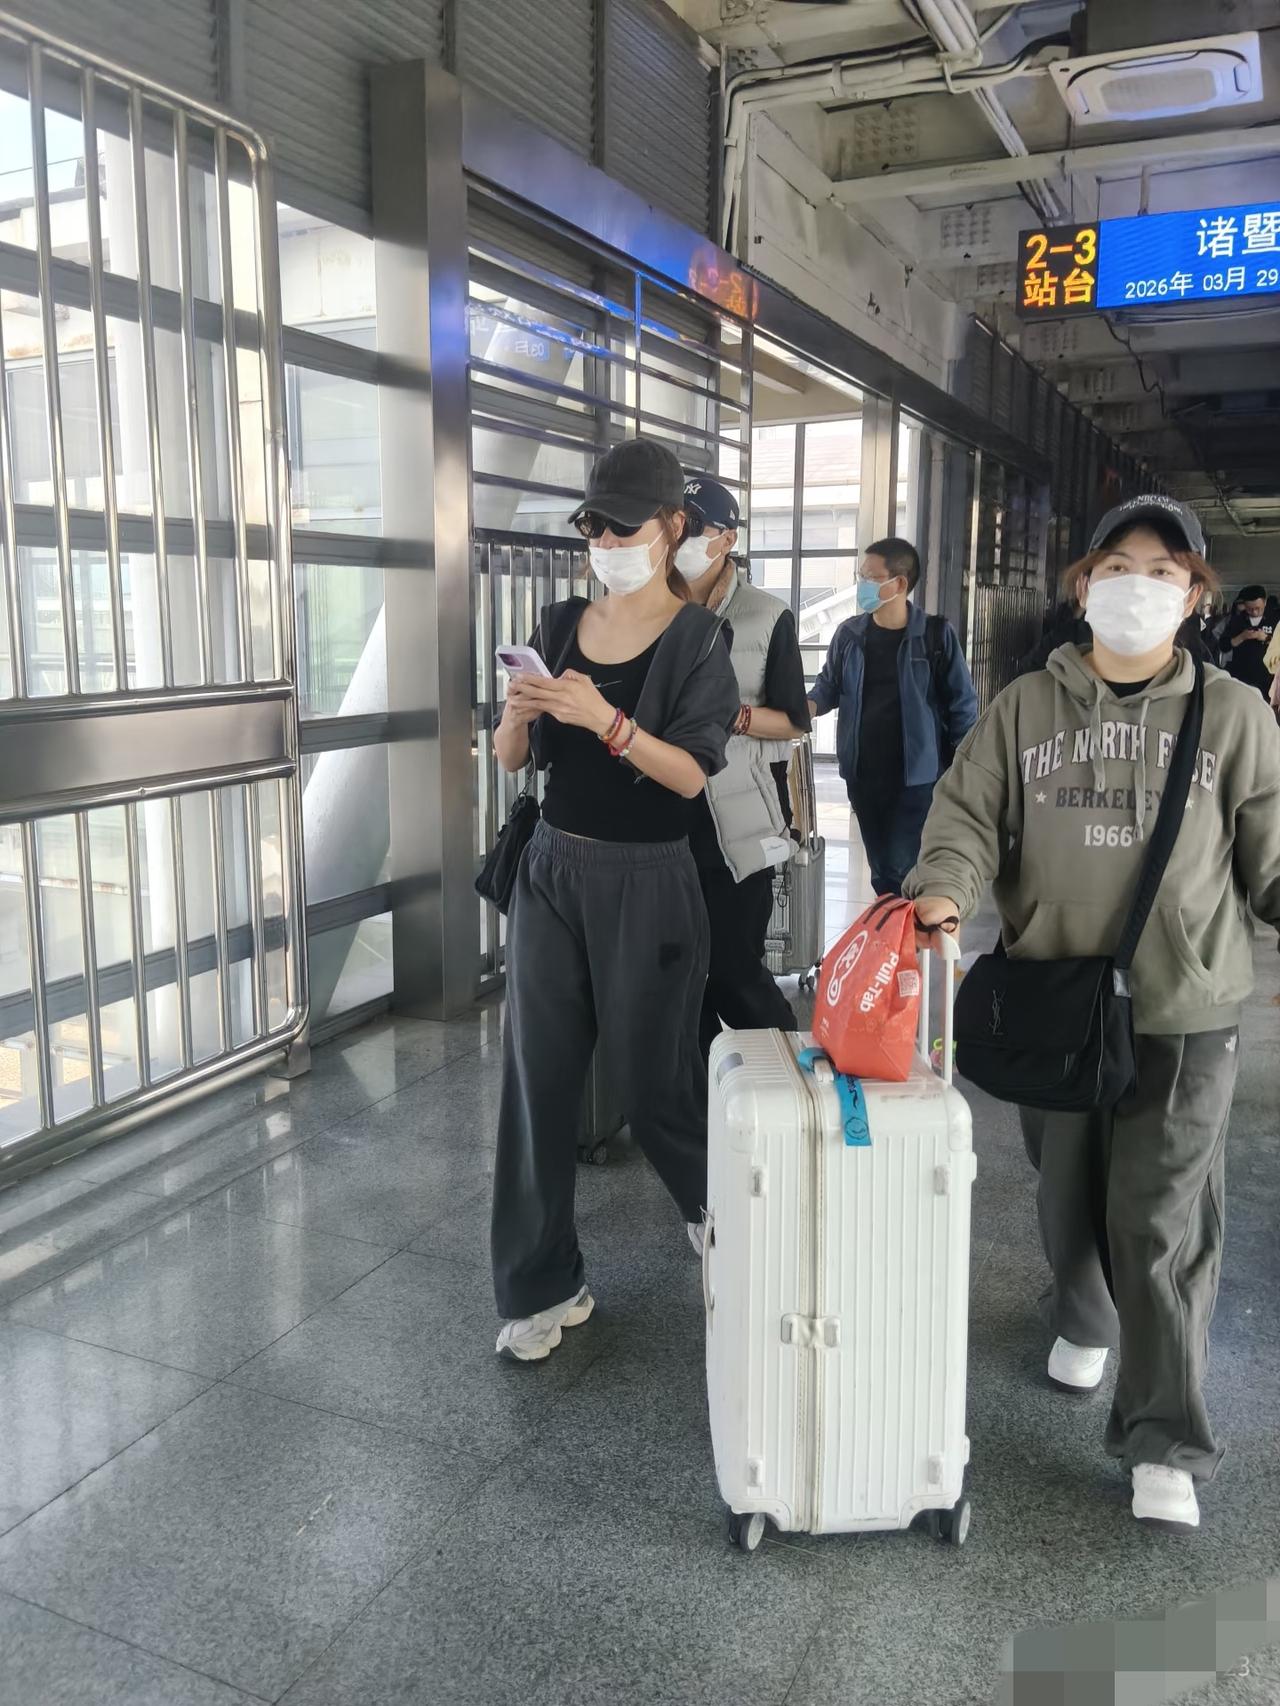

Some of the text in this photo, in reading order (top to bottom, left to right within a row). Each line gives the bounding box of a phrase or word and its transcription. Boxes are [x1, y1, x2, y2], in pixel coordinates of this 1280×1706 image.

[1196, 211, 1280, 259] 诸暨
[1023, 268, 1095, 307] 站台
[1124, 266, 1279, 299] 2026年 03月 29
[1022, 729, 1066, 785] THE
[1156, 729, 1217, 793] FE
[1084, 824, 1134, 847] 1966
[860, 952, 899, 1013] Pull-Tab
